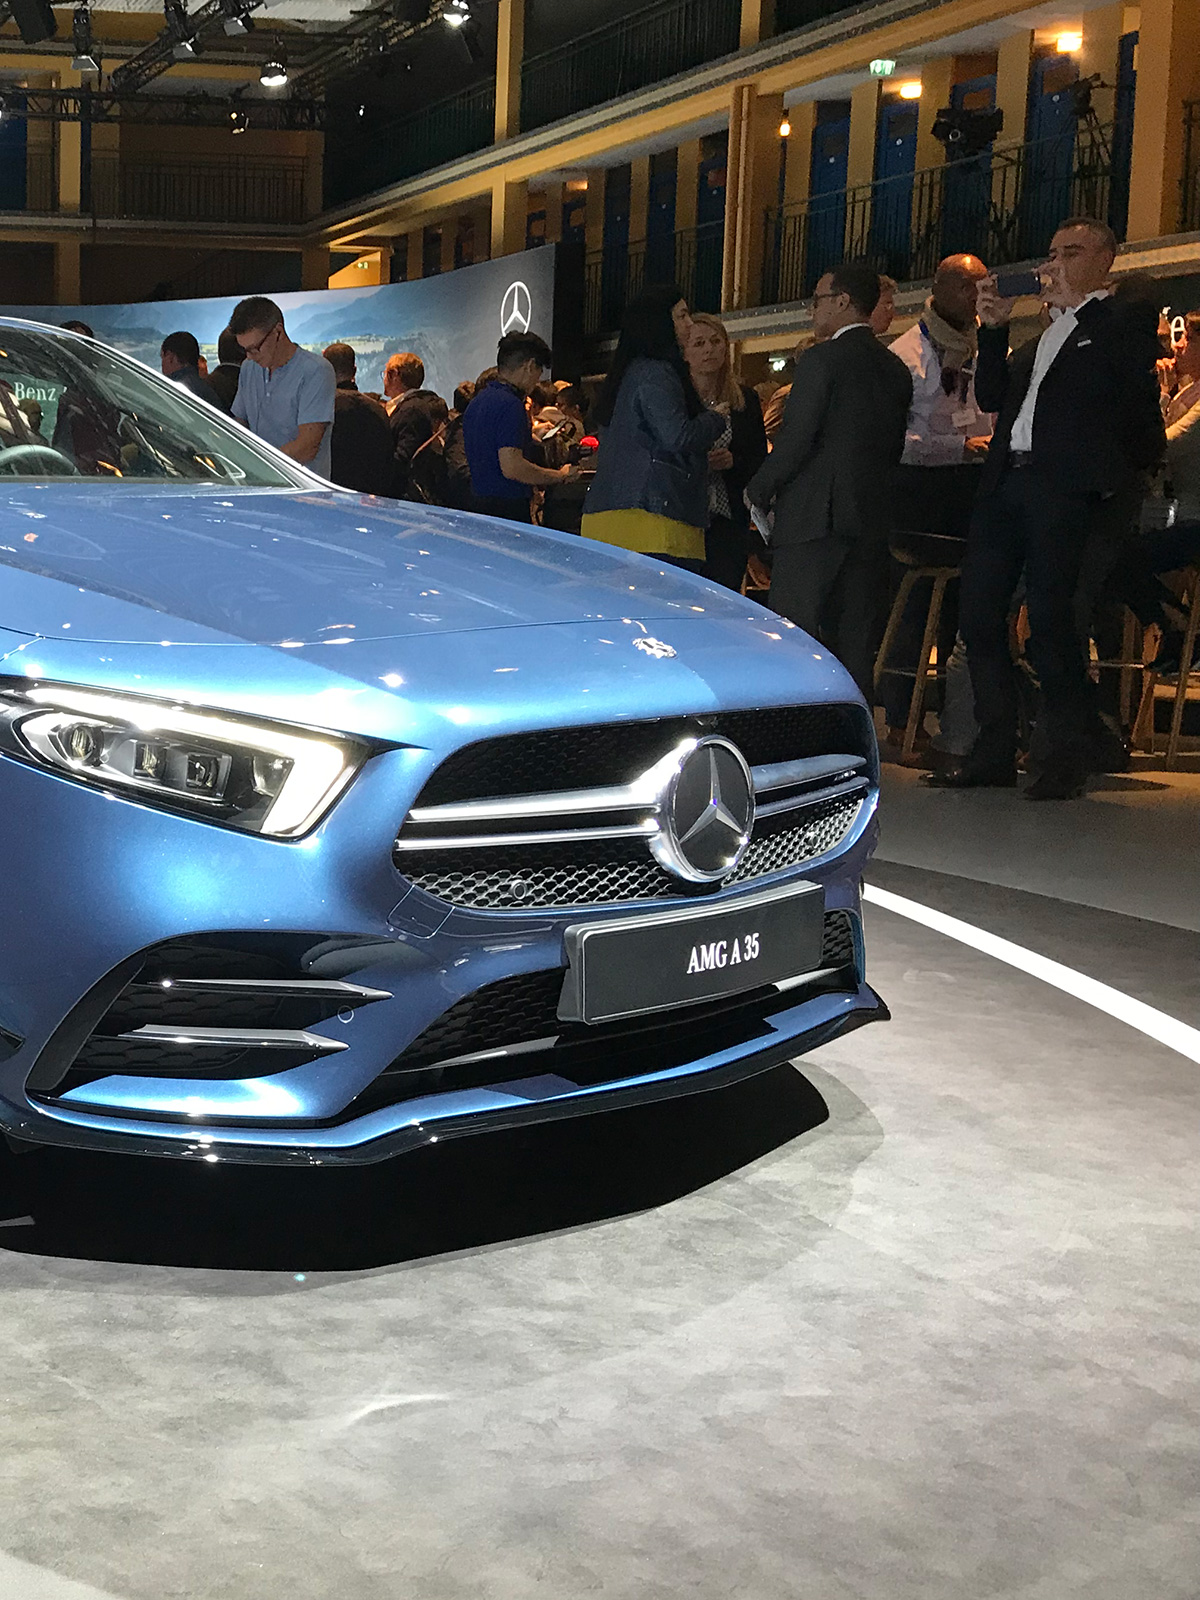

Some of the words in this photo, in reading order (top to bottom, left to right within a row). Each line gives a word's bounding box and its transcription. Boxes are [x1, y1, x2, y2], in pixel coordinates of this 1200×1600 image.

[13, 381, 57, 402] Benz
[686, 940, 728, 975] AMG
[729, 937, 742, 966] A
[743, 932, 760, 962] 35
